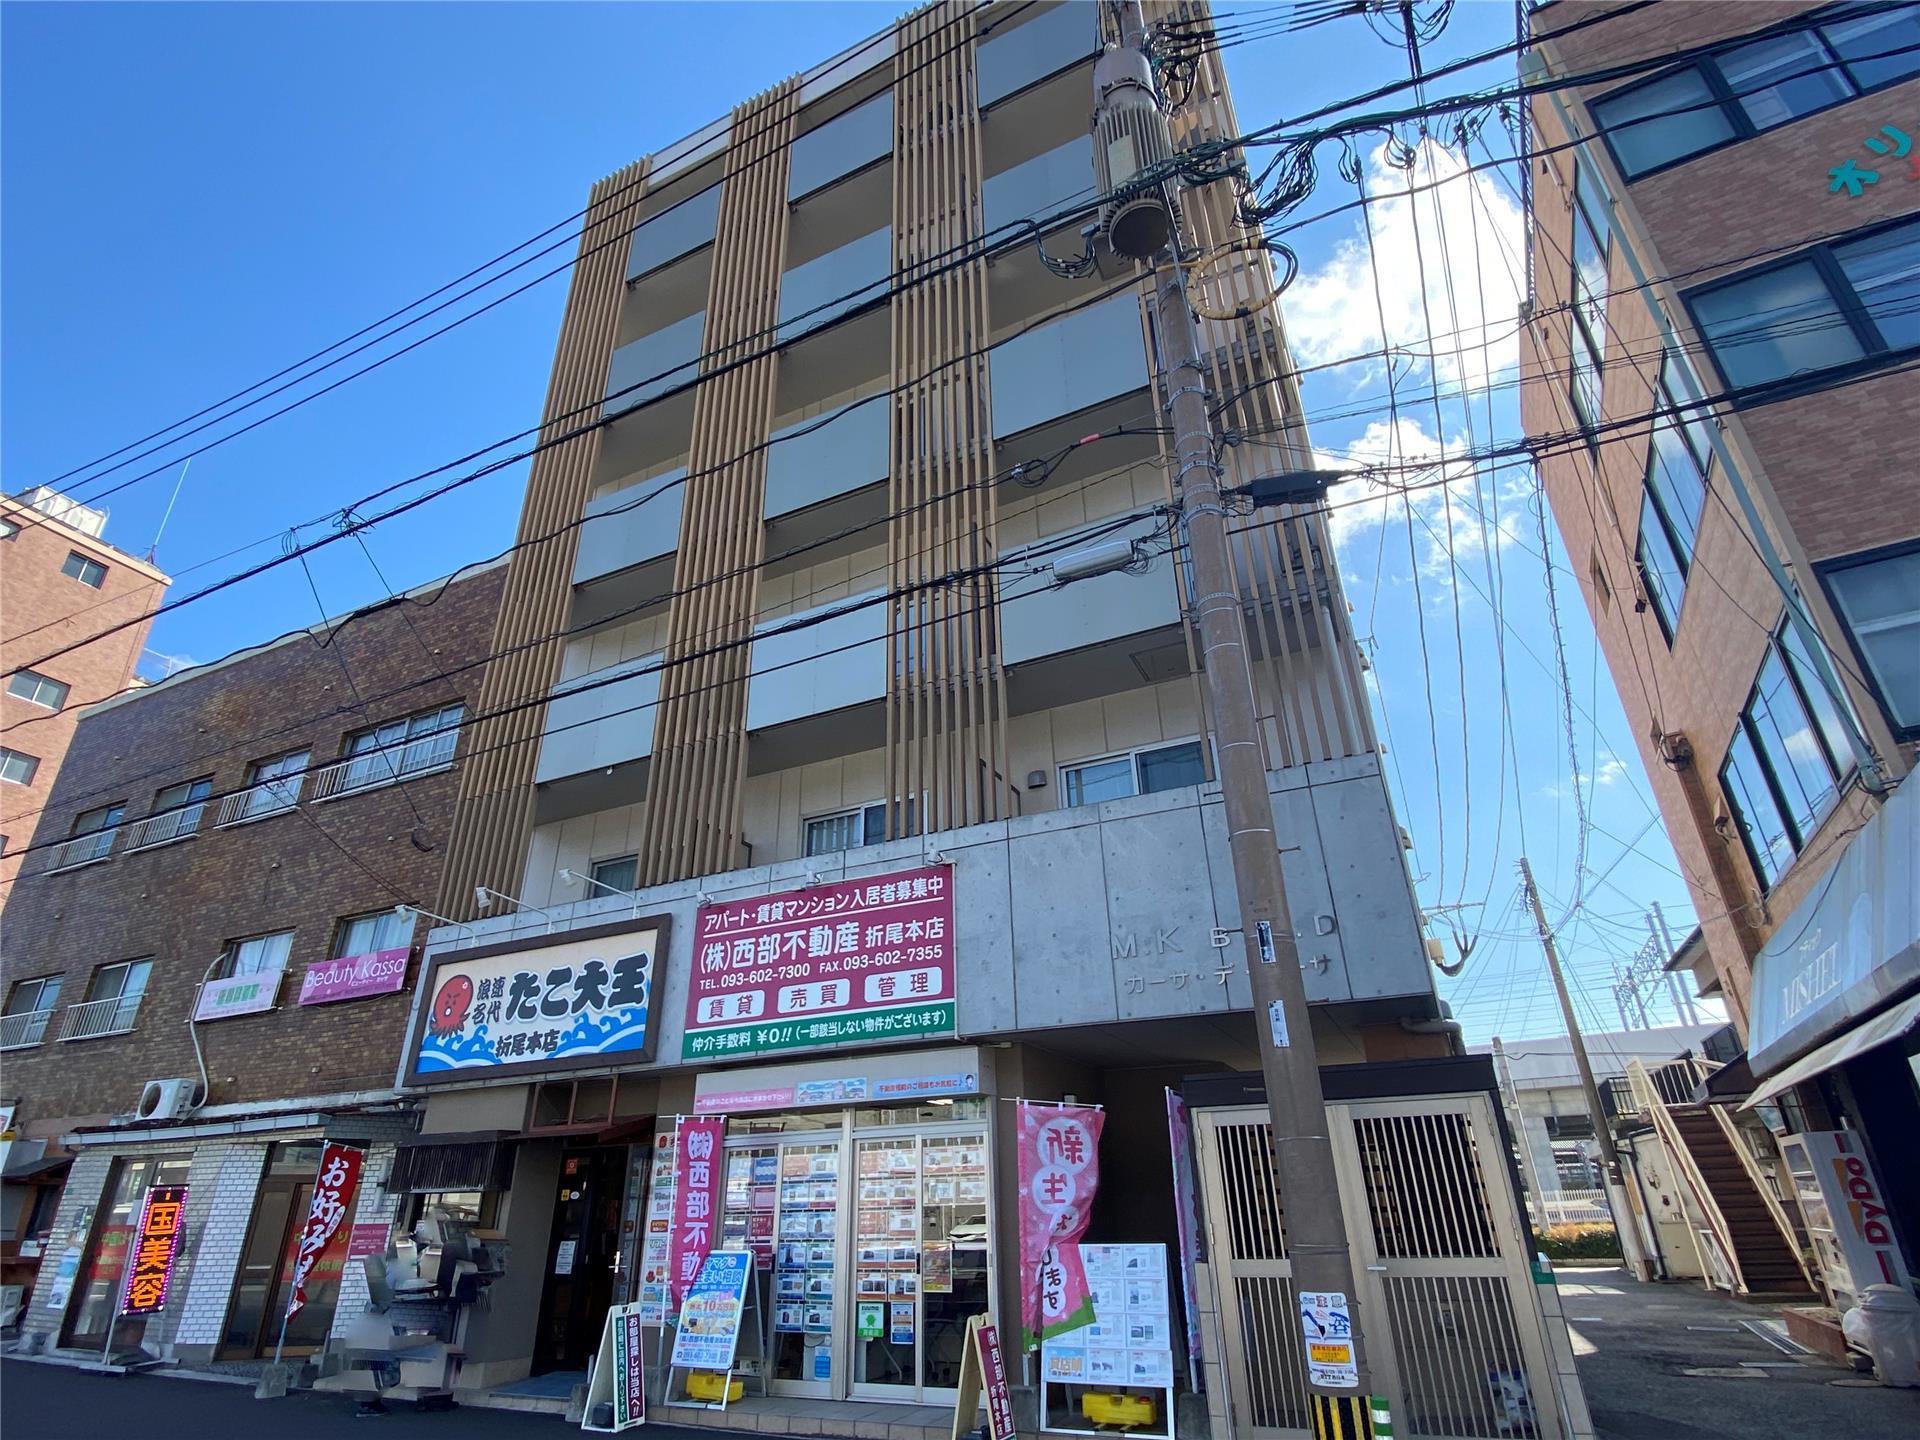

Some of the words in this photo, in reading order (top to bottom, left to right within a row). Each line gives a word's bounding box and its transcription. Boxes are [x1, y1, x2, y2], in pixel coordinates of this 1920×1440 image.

[704, 875, 943, 931] アパート・賃貸マンション入居者募集中
[865, 916, 944, 948] 折尾本店
[305, 964, 359, 988] Beauty
[360, 957, 406, 979] Kassa
[504, 951, 650, 1022] たこ大王
[477, 977, 506, 1000] 浪速
[495, 1028, 561, 1058] 折尾本店
[692, 1031, 751, 1052] 仲介手数料
[1846, 1157, 1890, 1245] DyDo
